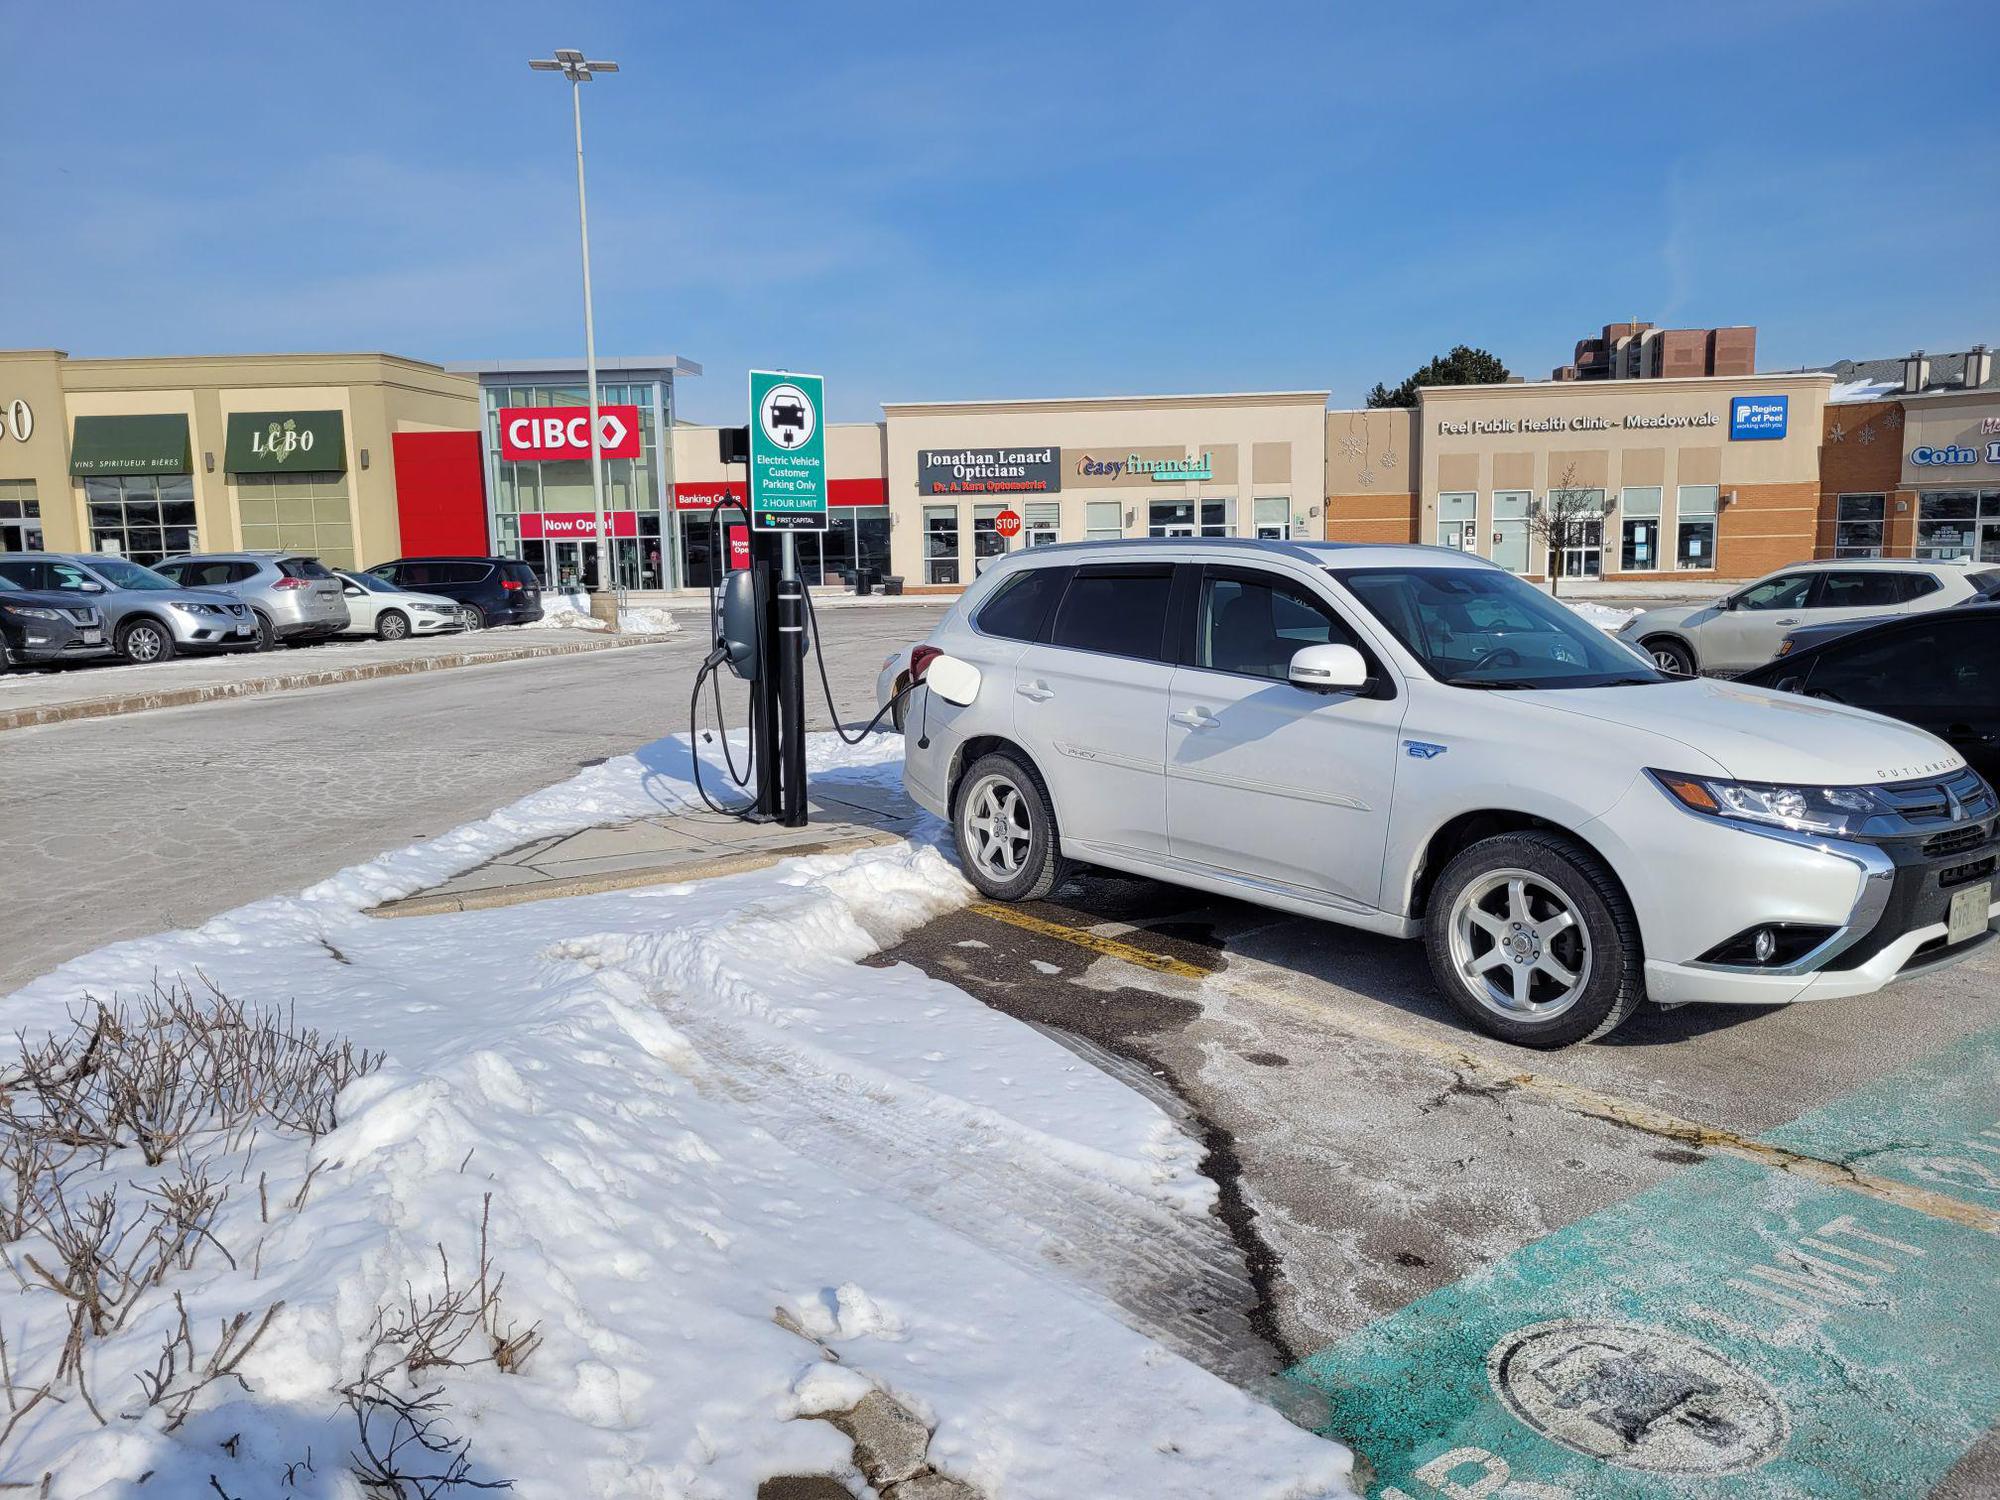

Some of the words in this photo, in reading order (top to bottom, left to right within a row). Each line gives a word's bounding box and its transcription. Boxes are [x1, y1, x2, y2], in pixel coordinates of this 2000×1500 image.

[1751, 405, 1783, 413] Region
[1439, 420, 1470, 434] Peel
[1475, 418, 1517, 433] Public
[1520, 417, 1567, 432] Health
[1571, 416, 1610, 430] Clinic
[1625, 411, 1720, 428] Meadowvale
[1751, 414, 1761, 422] of
[1763, 414, 1783, 422] Peel
[509, 417, 590, 449] CIBC
[252, 430, 314, 452] LCBO
[757, 455, 788, 465] Electric
[790, 456, 820, 466] Vehicle
[926, 451, 994, 468] Jonathan
[998, 449, 1052, 464] Lenard
[1911, 446, 1976, 464] Coin
[99, 460, 146, 468] SPIRITUEUX
[768, 467, 810, 478] Customer
[953, 464, 1026, 481] Opticians
[762, 479, 795, 490] Parking
[796, 480, 816, 491] Only
[679, 494, 712, 505] Banking
[713, 494, 741, 503] Cere
[762, 498, 768, 507] 2
[770, 499, 795, 507] HOUR
[796, 499, 817, 508] LIMIT
[545, 520, 573, 531] Now
[996, 519, 1020, 529] STOP
[1877, 757, 1958, 778] OUTLANDER
